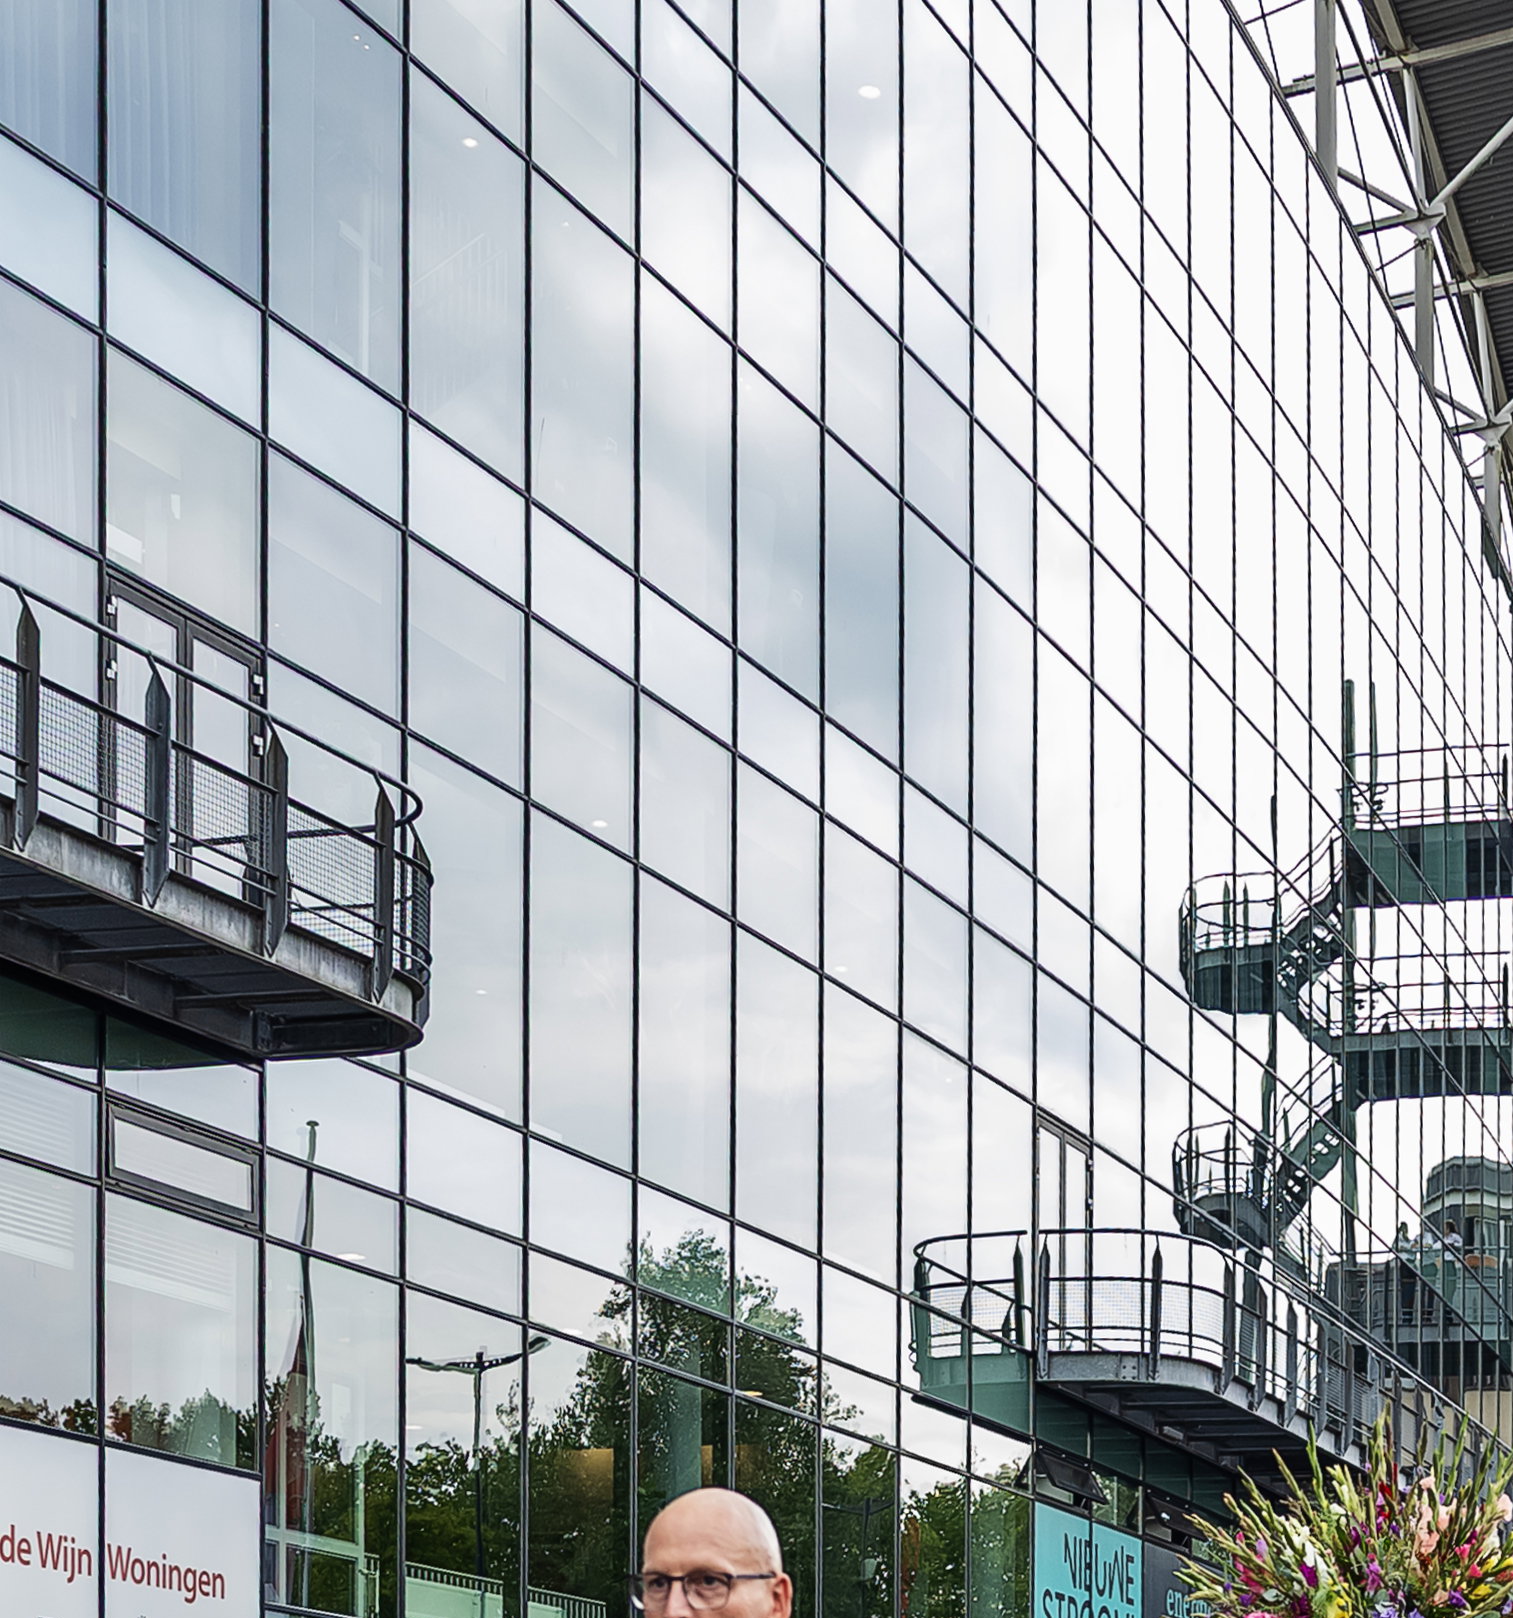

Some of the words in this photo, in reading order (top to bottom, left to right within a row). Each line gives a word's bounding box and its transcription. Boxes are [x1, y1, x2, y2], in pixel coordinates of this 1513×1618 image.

[0, 1524, 31, 1566] de
[36, 1531, 92, 1583] Wijn
[107, 1543, 225, 1603] Woningen
[1064, 1532, 1134, 1605] NIEUWE
